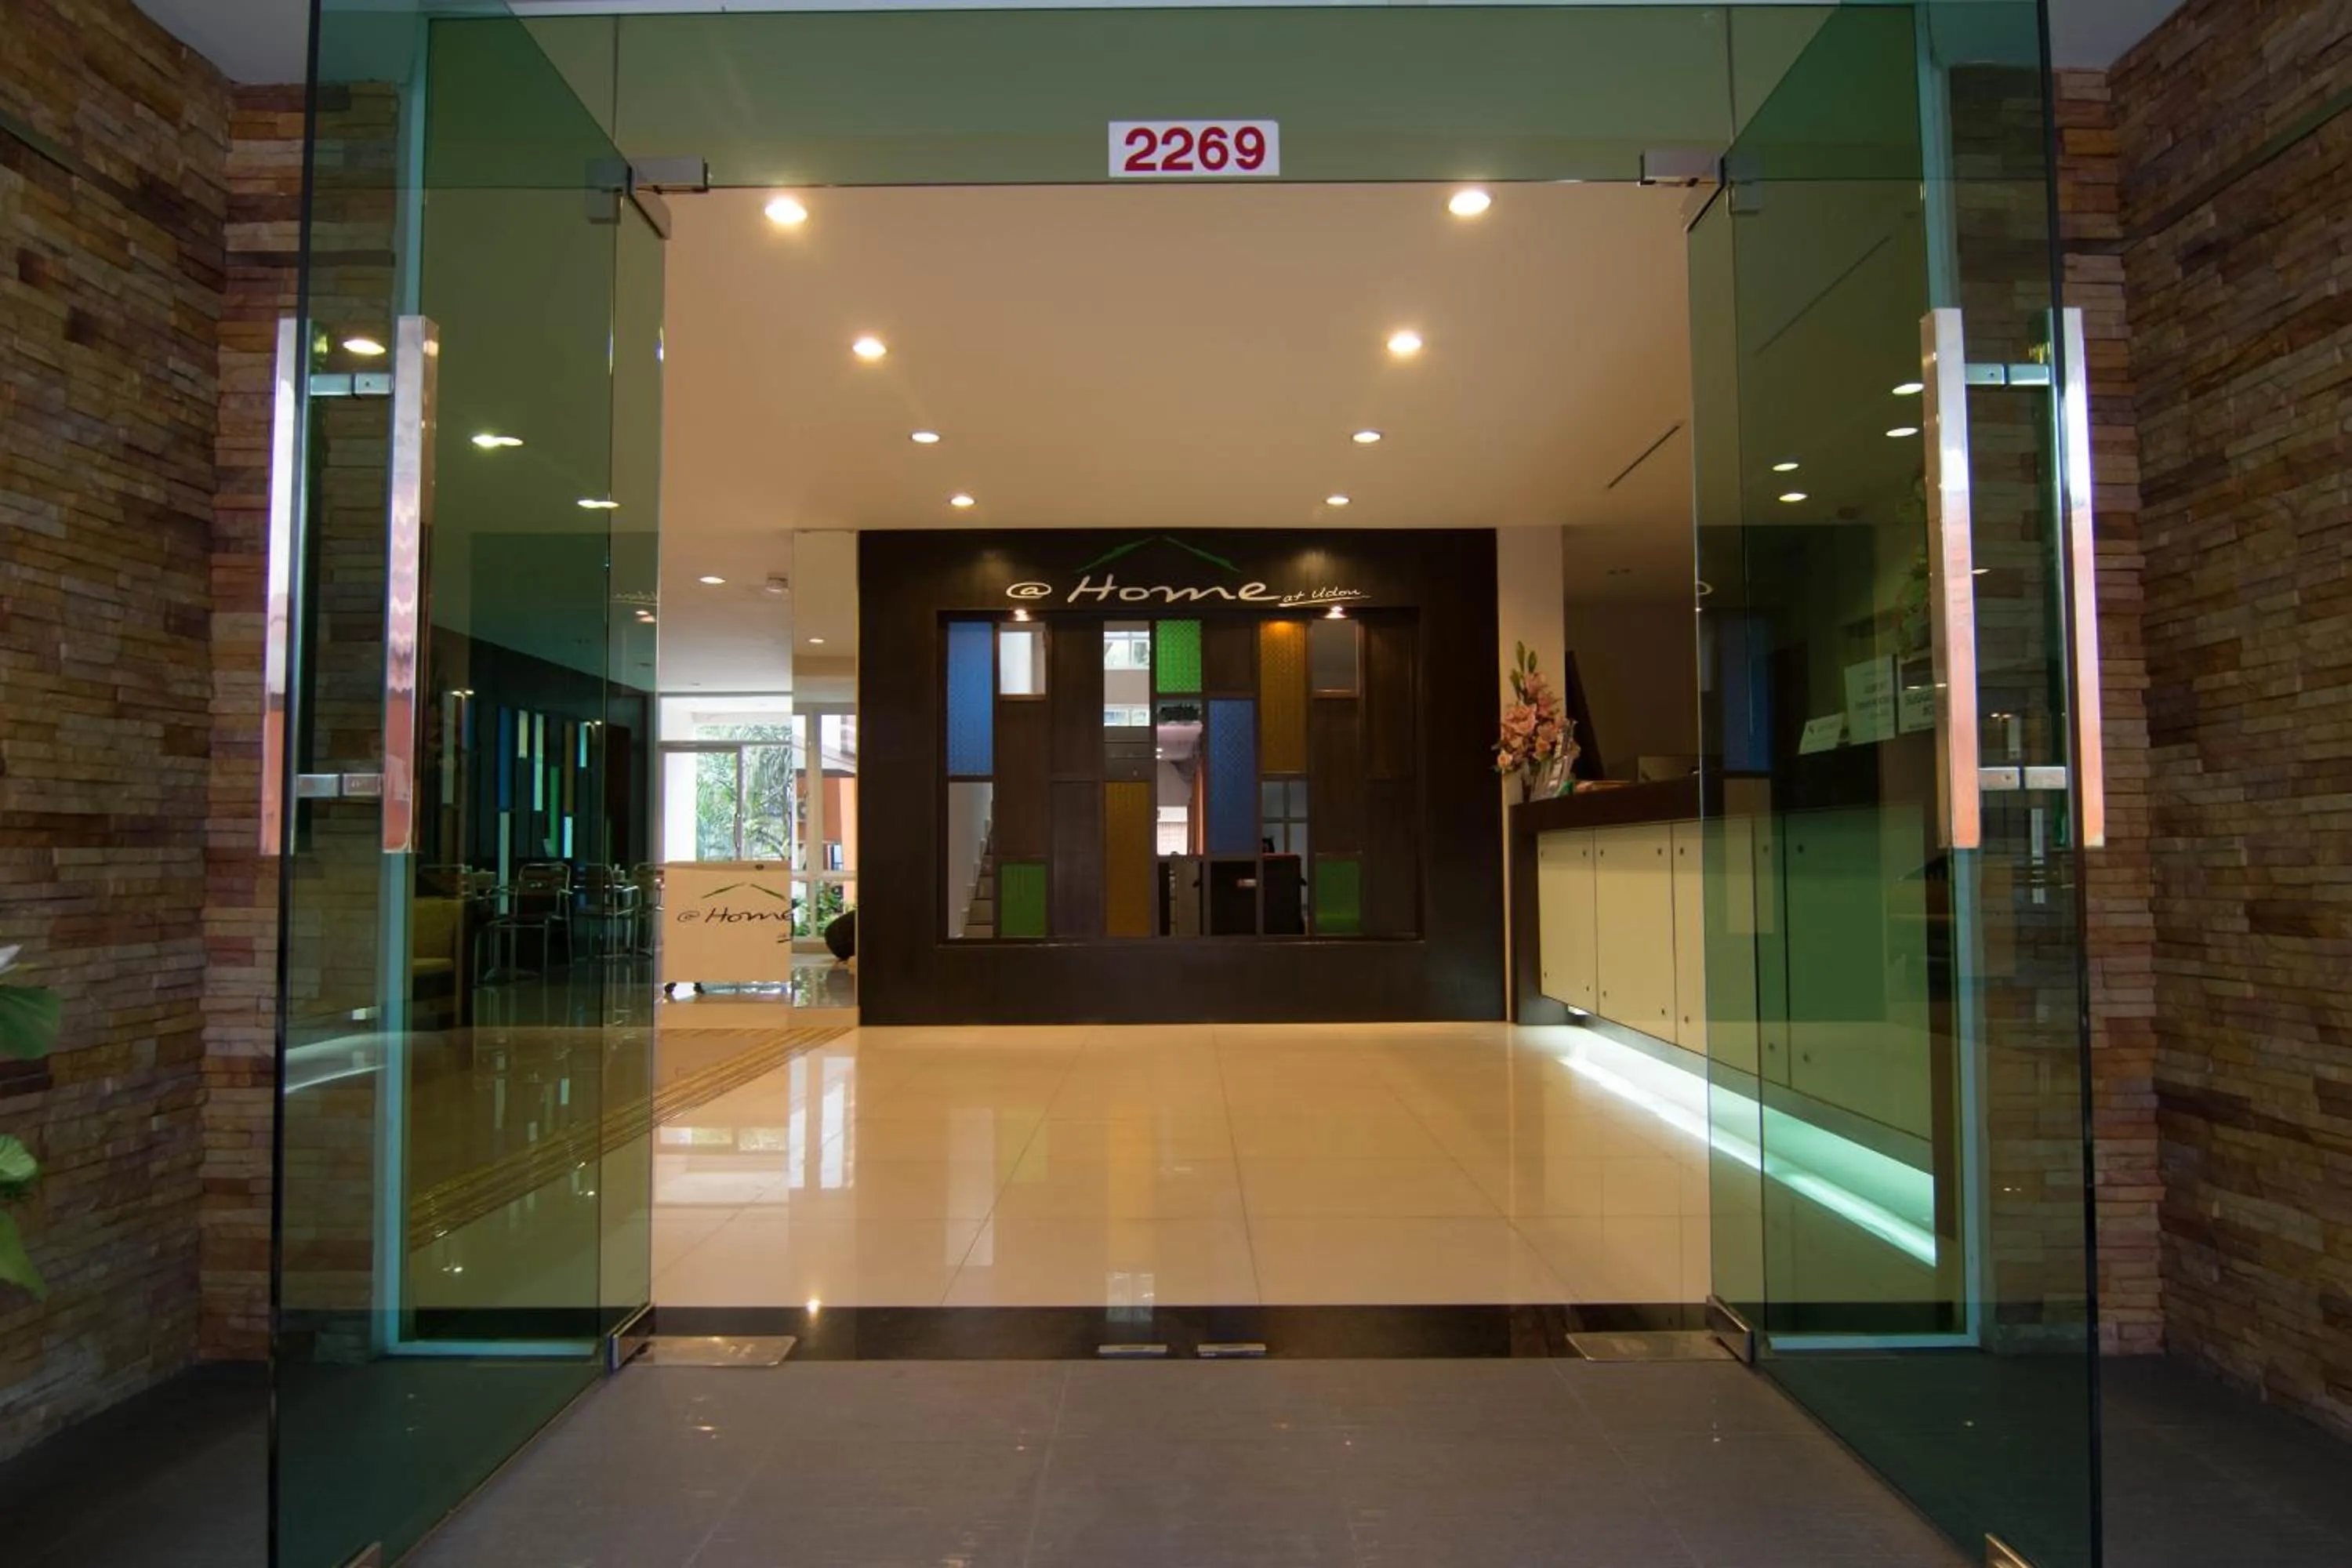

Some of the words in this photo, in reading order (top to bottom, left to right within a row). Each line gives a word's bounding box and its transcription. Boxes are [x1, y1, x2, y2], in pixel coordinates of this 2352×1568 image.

[1124, 126, 1265, 171] 2269
[1005, 582, 1052, 600] @
[1067, 573, 1282, 603] Home
[1283, 591, 1305, 603] at
[677, 910, 700, 923] @
